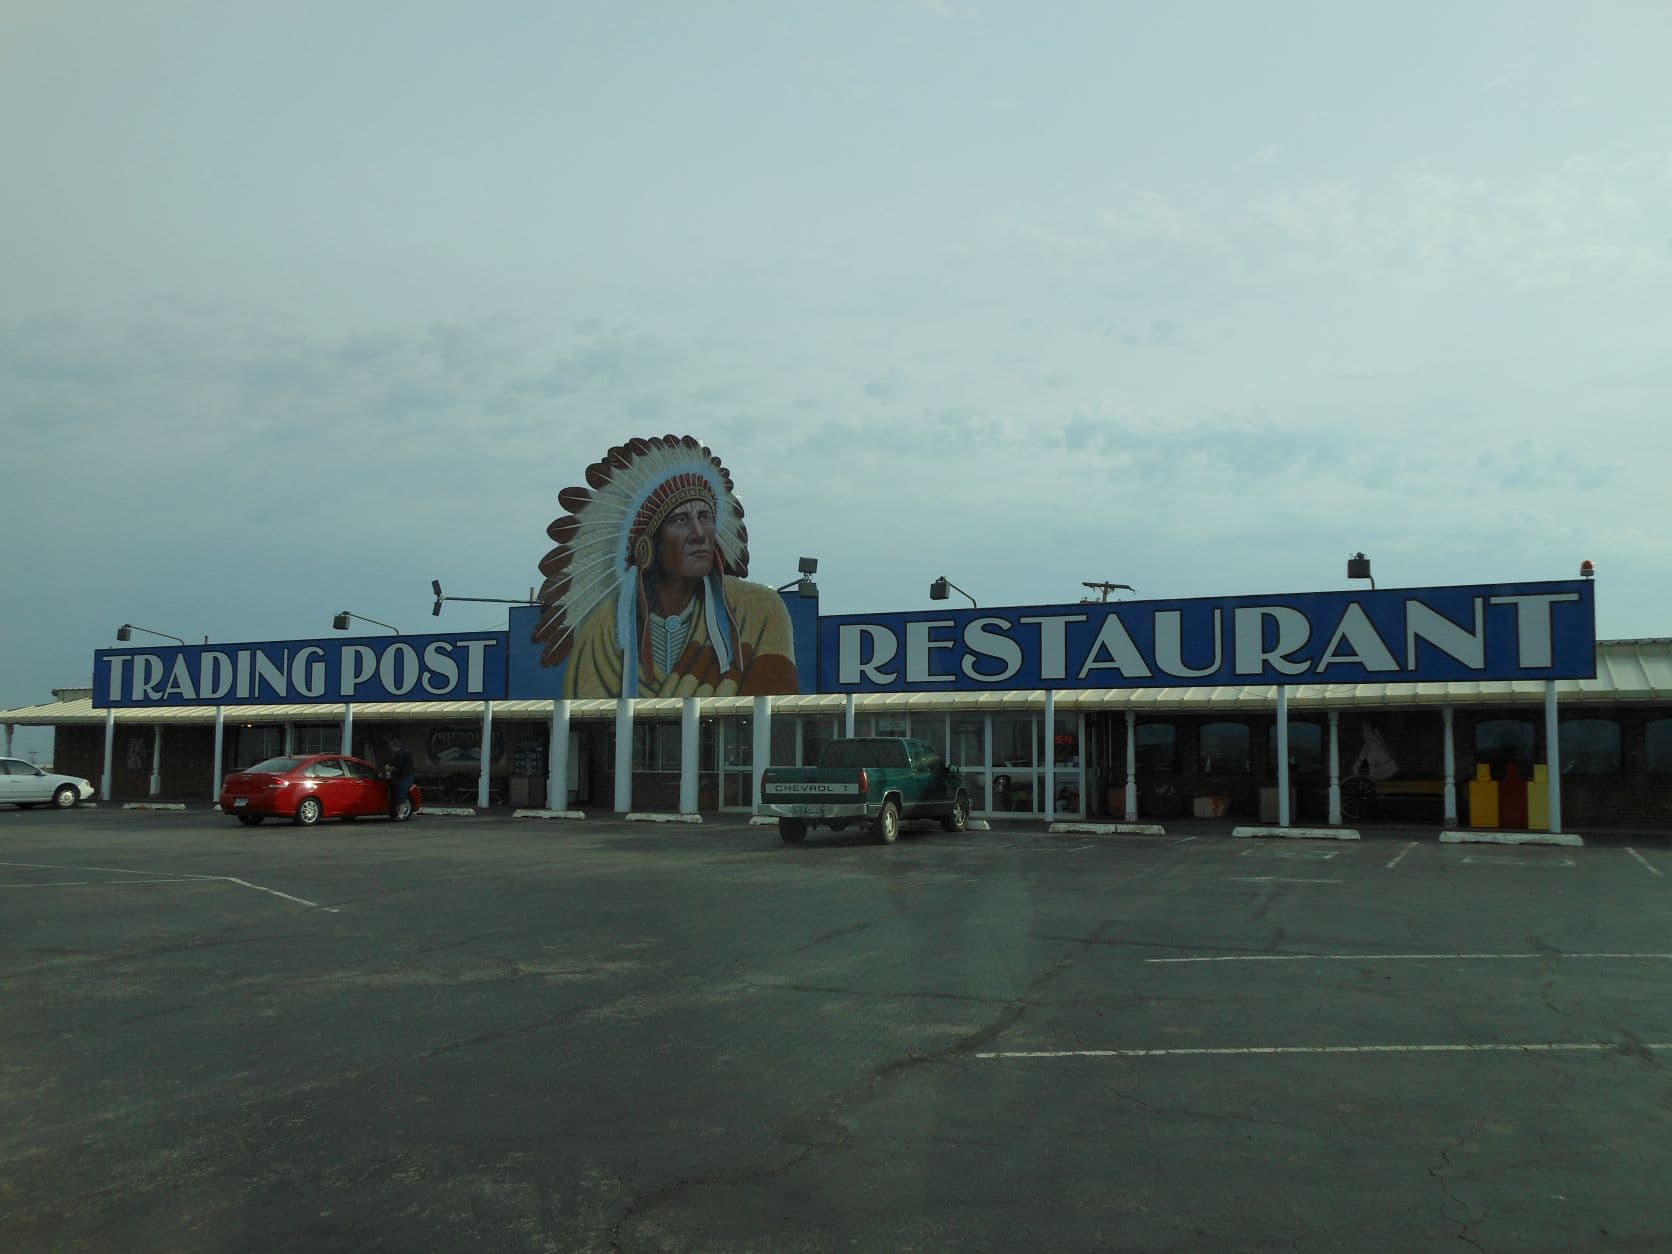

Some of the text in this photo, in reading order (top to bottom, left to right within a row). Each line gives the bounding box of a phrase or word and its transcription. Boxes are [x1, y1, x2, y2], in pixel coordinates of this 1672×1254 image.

[102, 638, 497, 701] TRADING POST
[838, 592, 1579, 686] RESTAURANT
